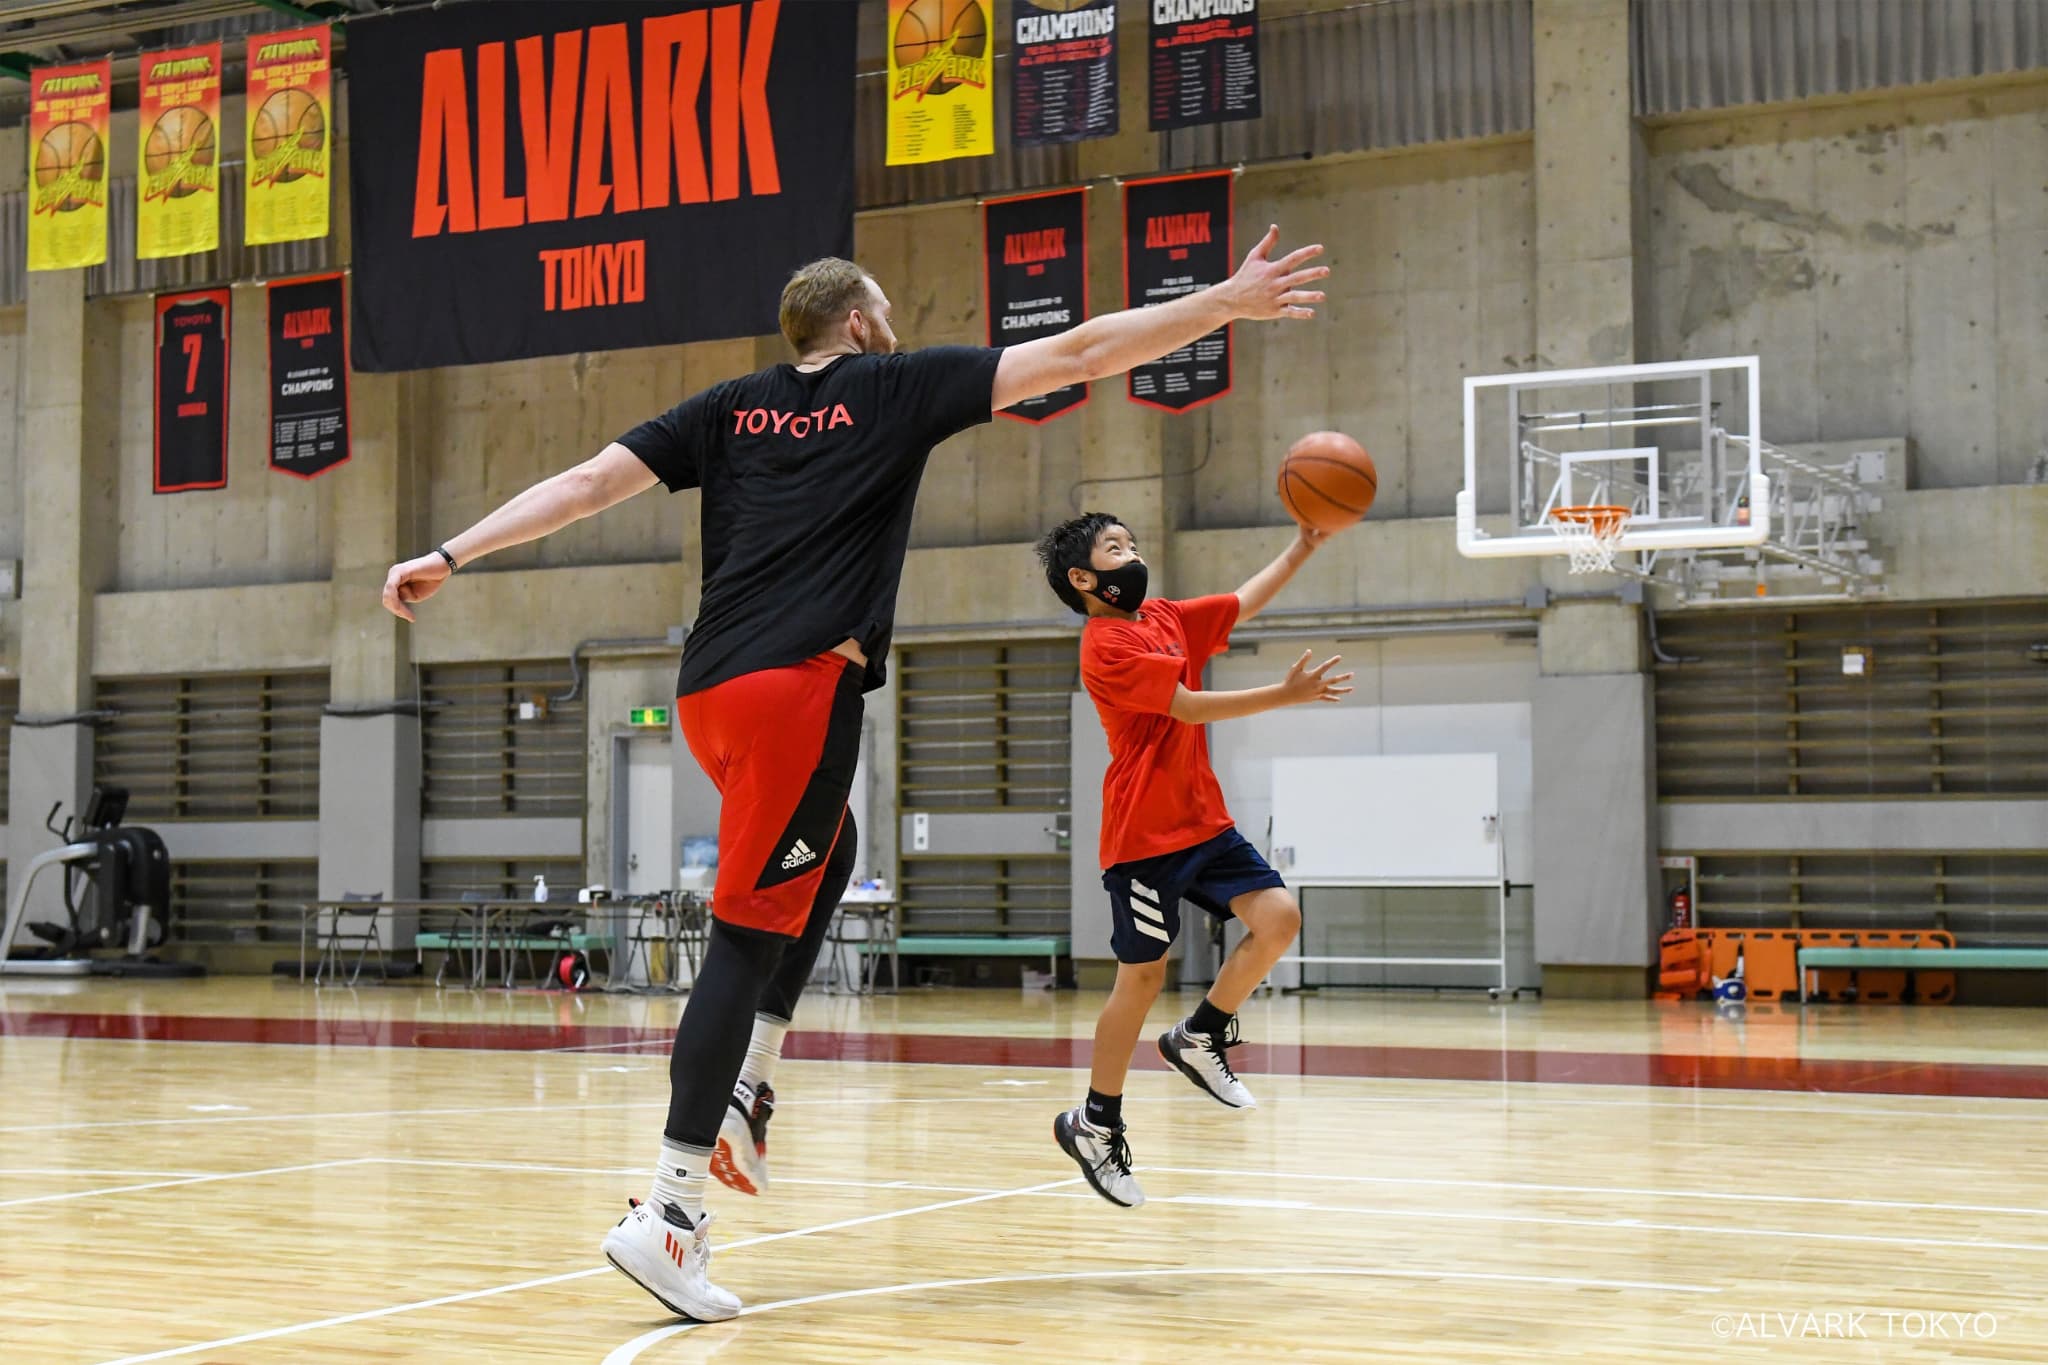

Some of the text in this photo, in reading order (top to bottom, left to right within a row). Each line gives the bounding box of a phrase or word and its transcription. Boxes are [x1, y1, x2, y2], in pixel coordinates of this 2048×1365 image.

[1016, 5, 1115, 44] CHAMPIONS
[412, 0, 781, 238] ALVARK
[1004, 228, 1066, 265] ALVARK
[1145, 212, 1211, 249] ALVARK
[539, 240, 645, 311] TOKYO
[1002, 309, 1070, 330] CHAMPIONS
[183, 333, 202, 393] 7
[281, 377, 334, 396] CHAMPIONS
[733, 403, 854, 438] TOYOTA
[781, 851, 816, 870] adidas
